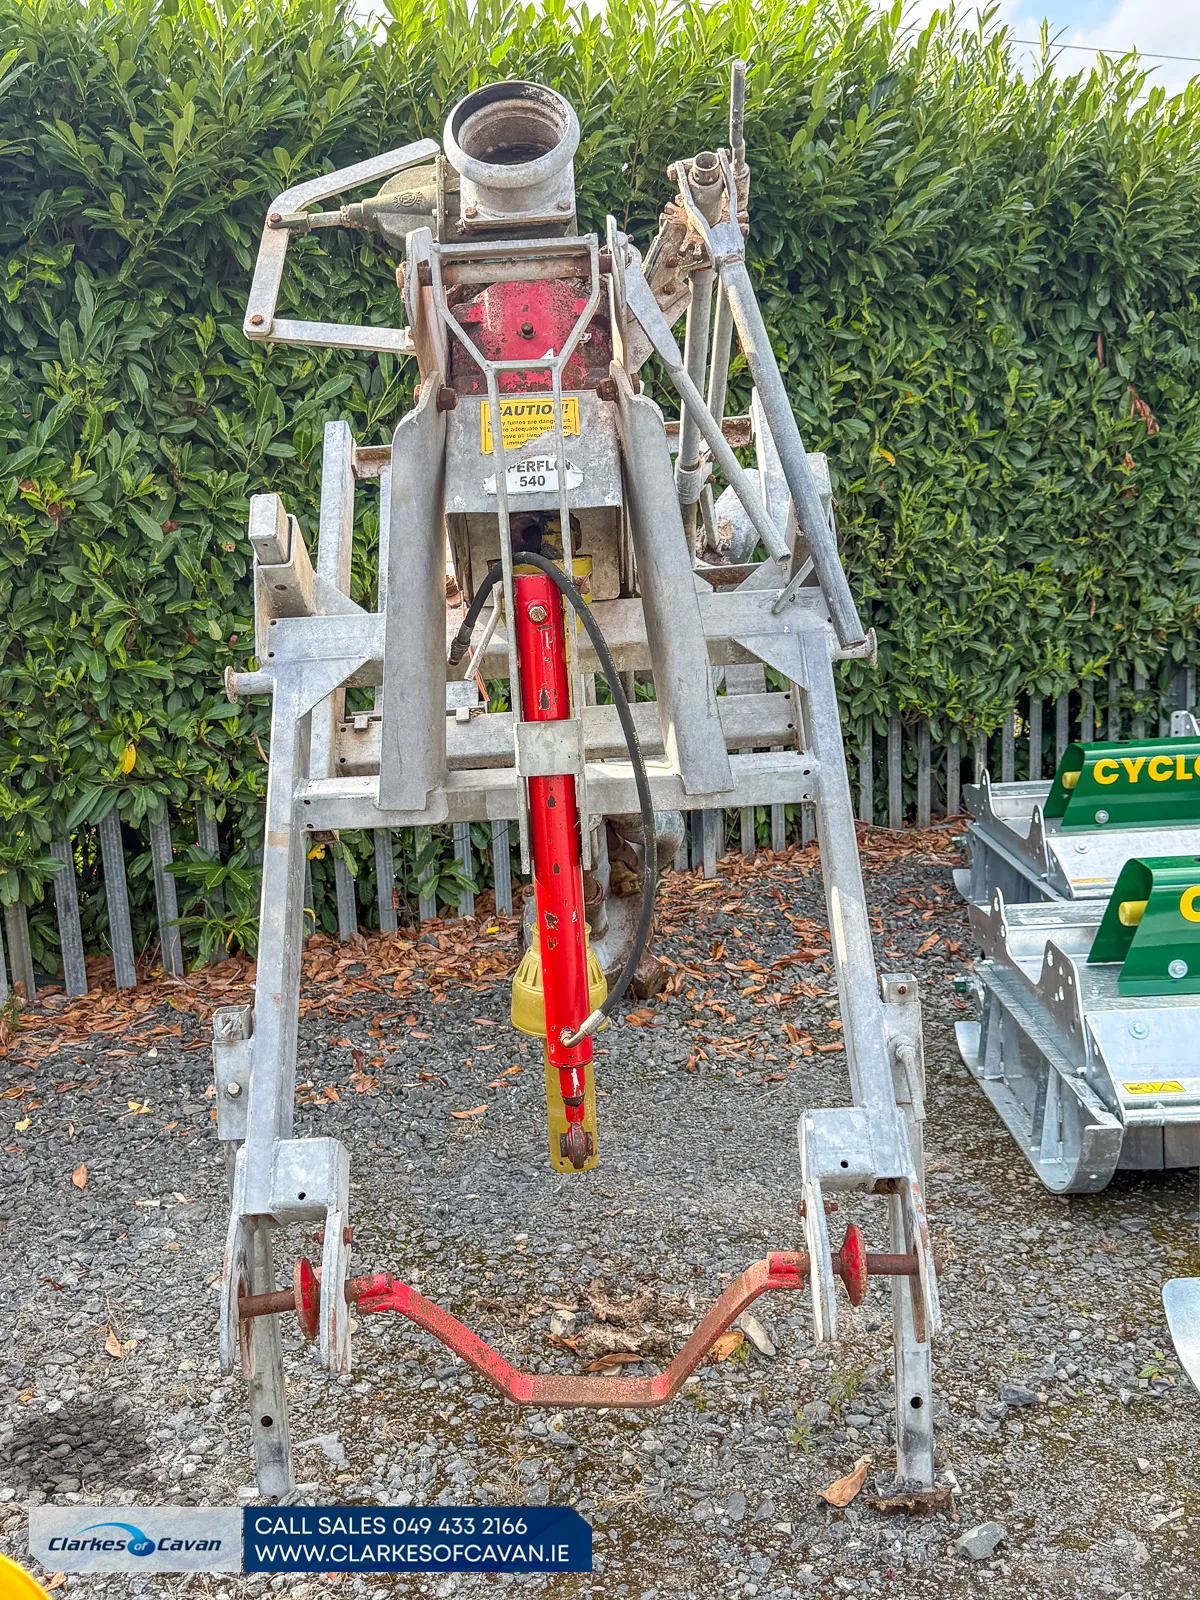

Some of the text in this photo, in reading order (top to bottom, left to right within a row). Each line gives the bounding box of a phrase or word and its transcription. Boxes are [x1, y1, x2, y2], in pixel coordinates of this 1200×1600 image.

[499, 403, 569, 417] AUTIO!
[510, 426, 539, 434] adequate
[519, 475, 546, 487] 540
